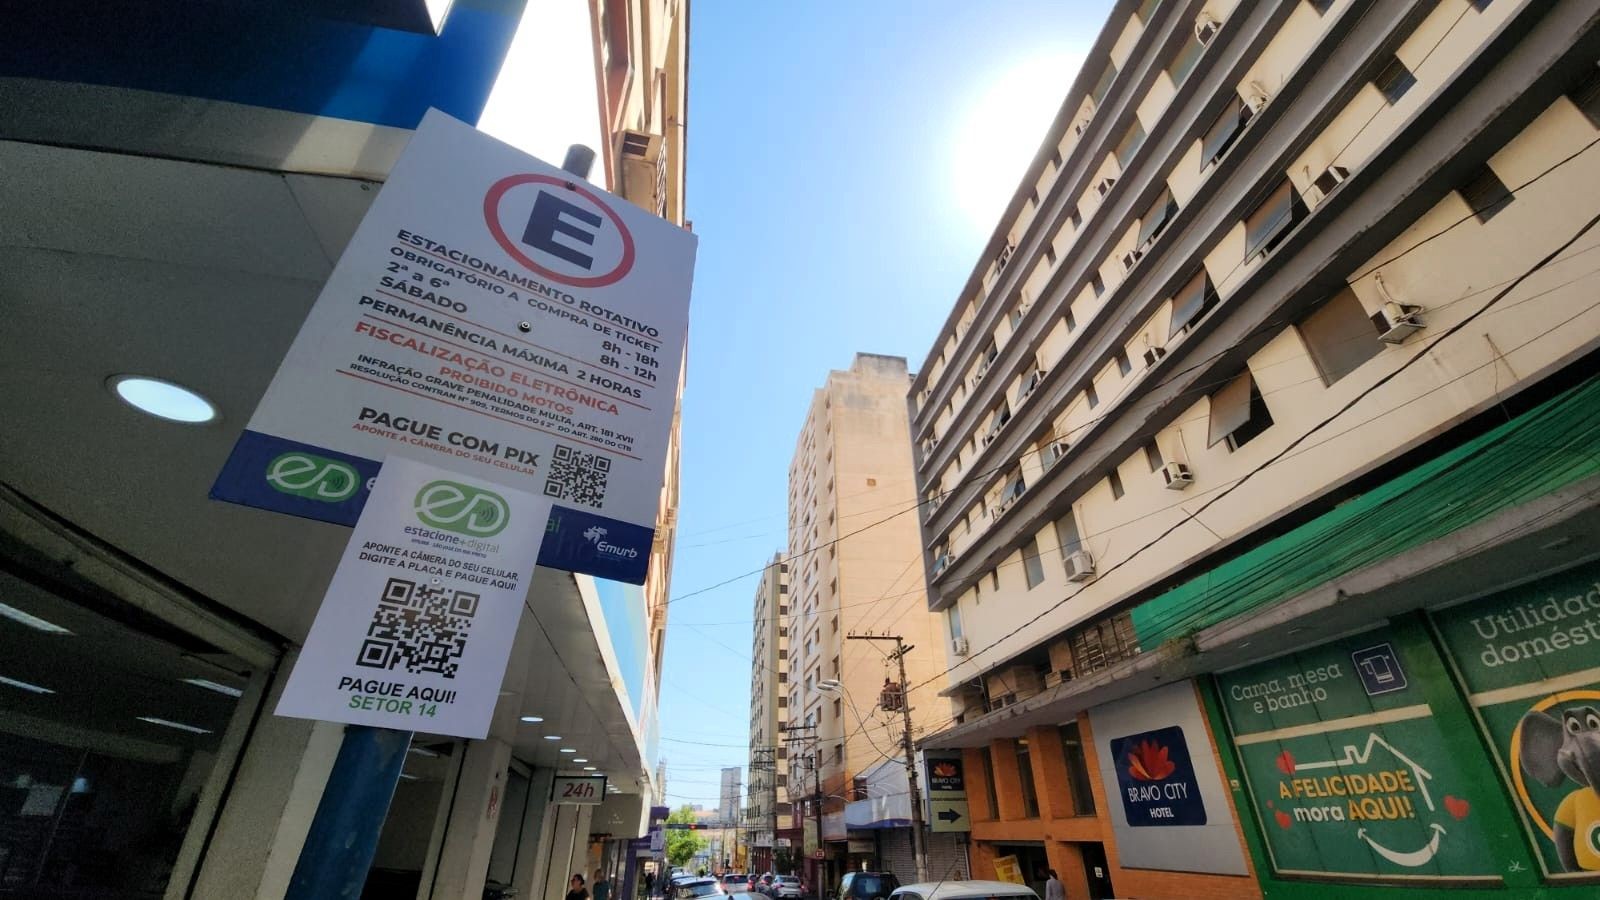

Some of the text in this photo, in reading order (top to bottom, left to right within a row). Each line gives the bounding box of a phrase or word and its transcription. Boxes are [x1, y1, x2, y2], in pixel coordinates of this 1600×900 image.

[521, 190, 602, 271] E
[390, 247, 659, 353] OBRIGATÓRIO A COMPRA DE TICKET
[397, 229, 659, 338] ESTACIONAMENTO ROTATIVO
[380, 275, 468, 313] SÁBADO
[600, 354, 619, 369] 8h
[633, 366, 657, 381] 12h
[412, 272, 424, 282] a
[602, 340, 621, 355] 8h
[635, 352, 659, 368] 18h
[355, 322, 619, 416] FISCALIZAÇÃO ELETRÔNICA
[359, 296, 642, 400] PERMANÊNCIA MÁXIMA 2 HORAS
[350, 363, 409, 385] RESOLUÇÃO
[411, 382, 456, 400] CONTRAN
[491, 405, 525, 420] TERMOS
[526, 416, 539, 424] DO
[557, 425, 570, 433] DO
[571, 429, 588, 440] ART.
[604, 439, 616, 447] DO
[617, 442, 632, 452] CTB
[358, 354, 634, 444] INFRAÇÃO GRAVE PENALIDADE MULTA, ART. 181 XVII
[439, 366, 575, 415] PROIBIDO MOTOS
[352, 423, 535, 475] APONTE A CÂMERA DO SEU CELULAR
[358, 407, 541, 467] PAGUE COM PIX
[359, 552, 517, 591] DIGITE A PLACA E PAGUE AQUI!
[363, 541, 401, 556] APONTE
[402, 549, 408, 557] A
[411, 551, 447, 565] CÂMERA
[448, 559, 460, 568] DO
[463, 562, 480, 572] SEU
[596, 541, 638, 558] Emurb
[338, 676, 456, 704] PAGUE AQUI!
[1288, 663, 1343, 687] mesa
[348, 695, 436, 718] SETOR 14
[1253, 686, 1328, 713] e banho
[562, 783, 594, 798] 24h
[1128, 782, 1188, 804] BRAVO CITY
[1279, 769, 1416, 800] A FELICIDADE
[1149, 806, 1174, 819] HOTEL
[1294, 795, 1415, 823] mora AQUI!
